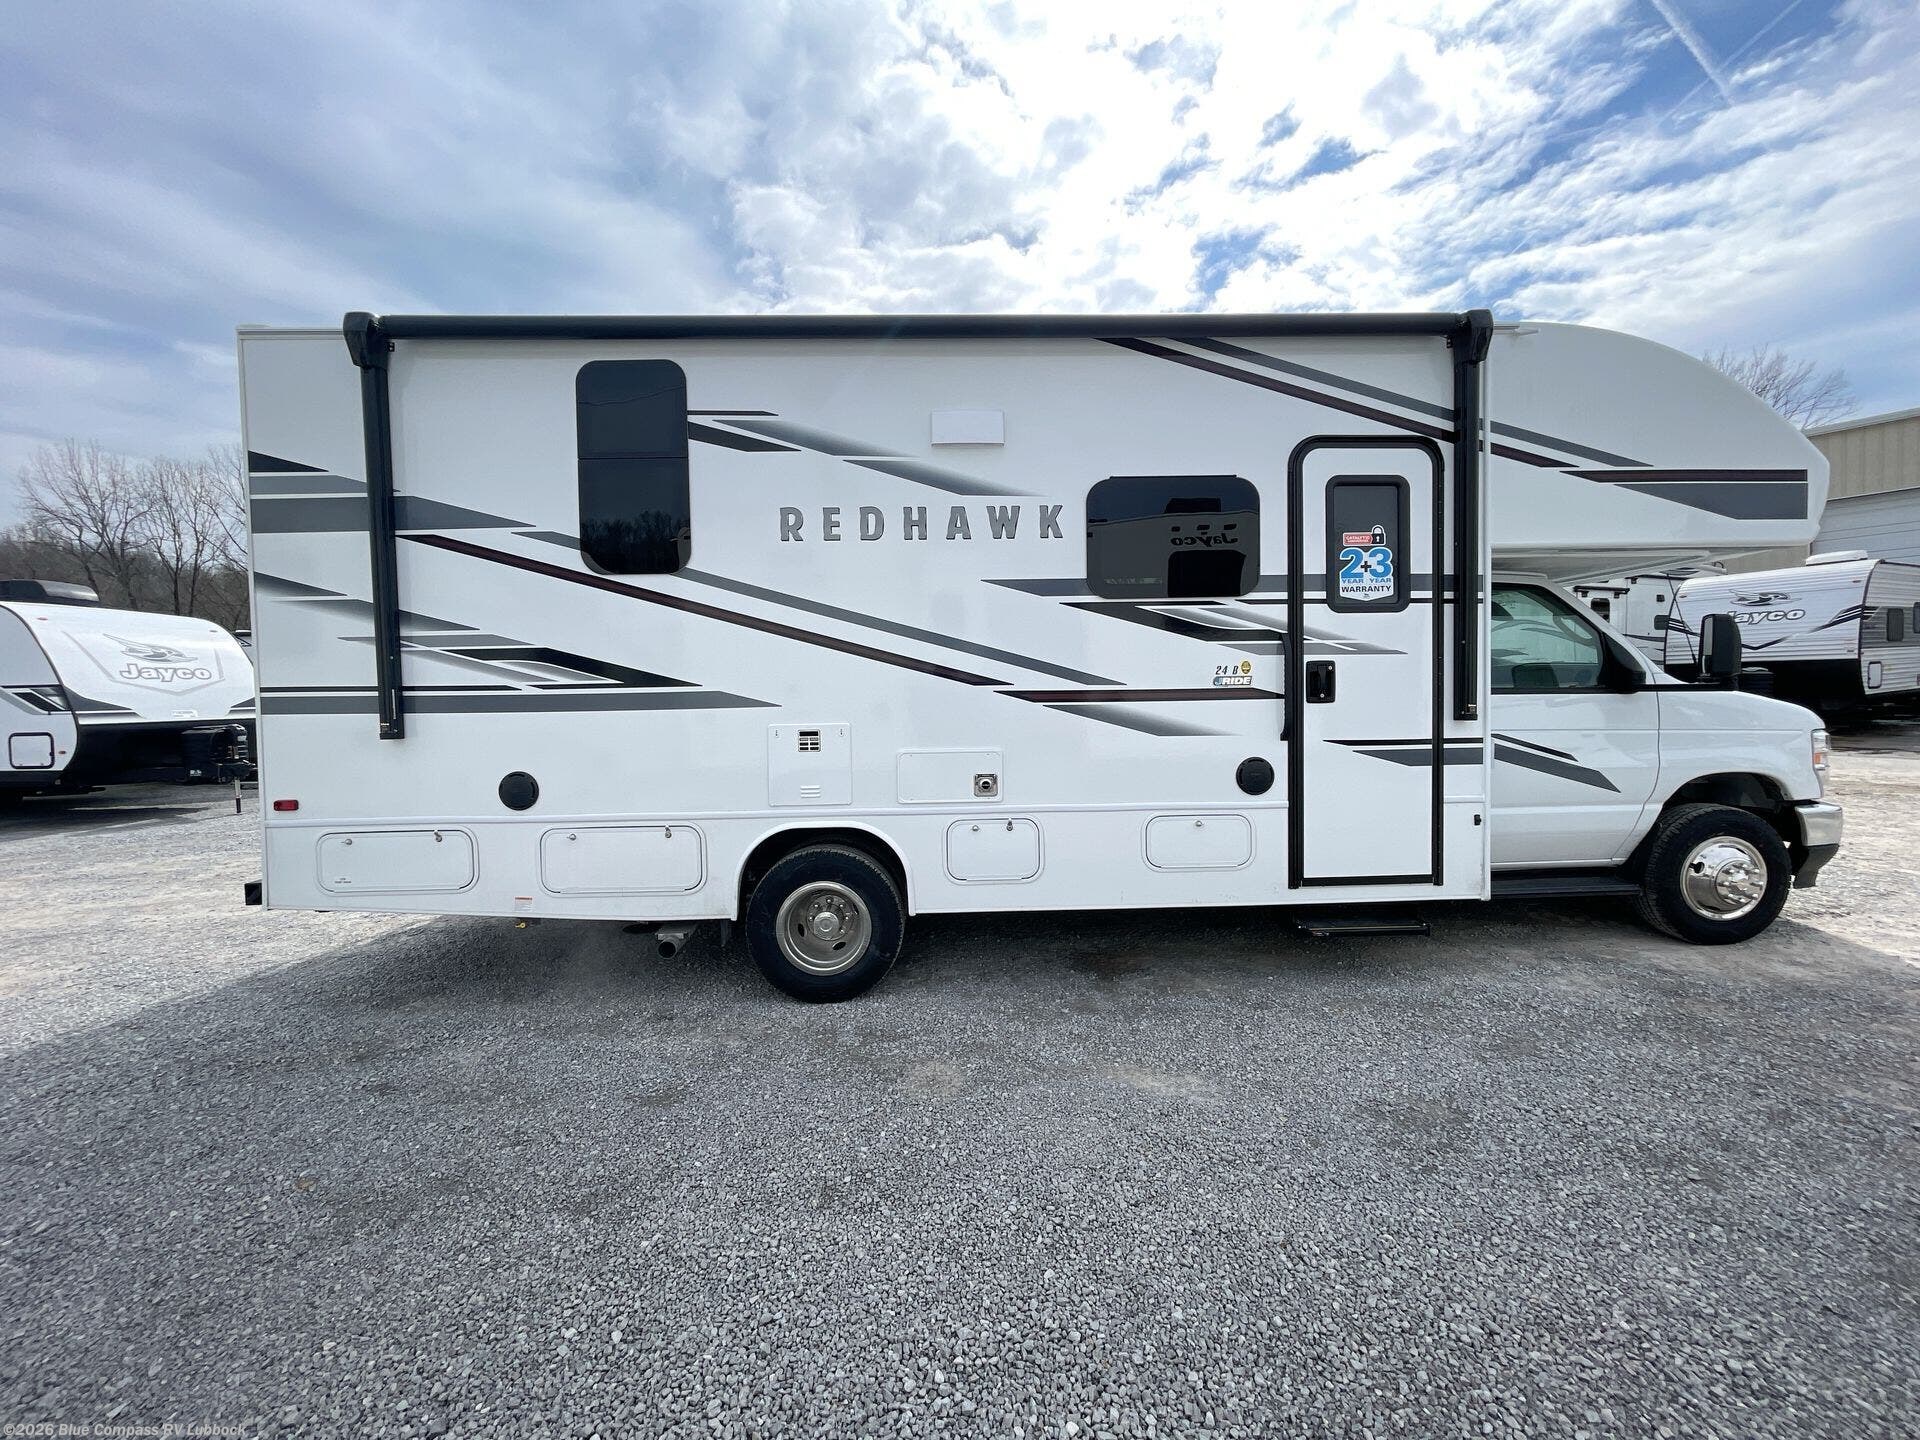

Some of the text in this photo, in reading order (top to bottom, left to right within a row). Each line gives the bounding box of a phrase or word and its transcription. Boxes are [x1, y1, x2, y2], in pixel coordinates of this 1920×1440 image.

[779, 505, 1064, 541] REDHAWK
[1341, 585, 1392, 593] WARRANTY
[119, 663, 212, 683] Jayco
